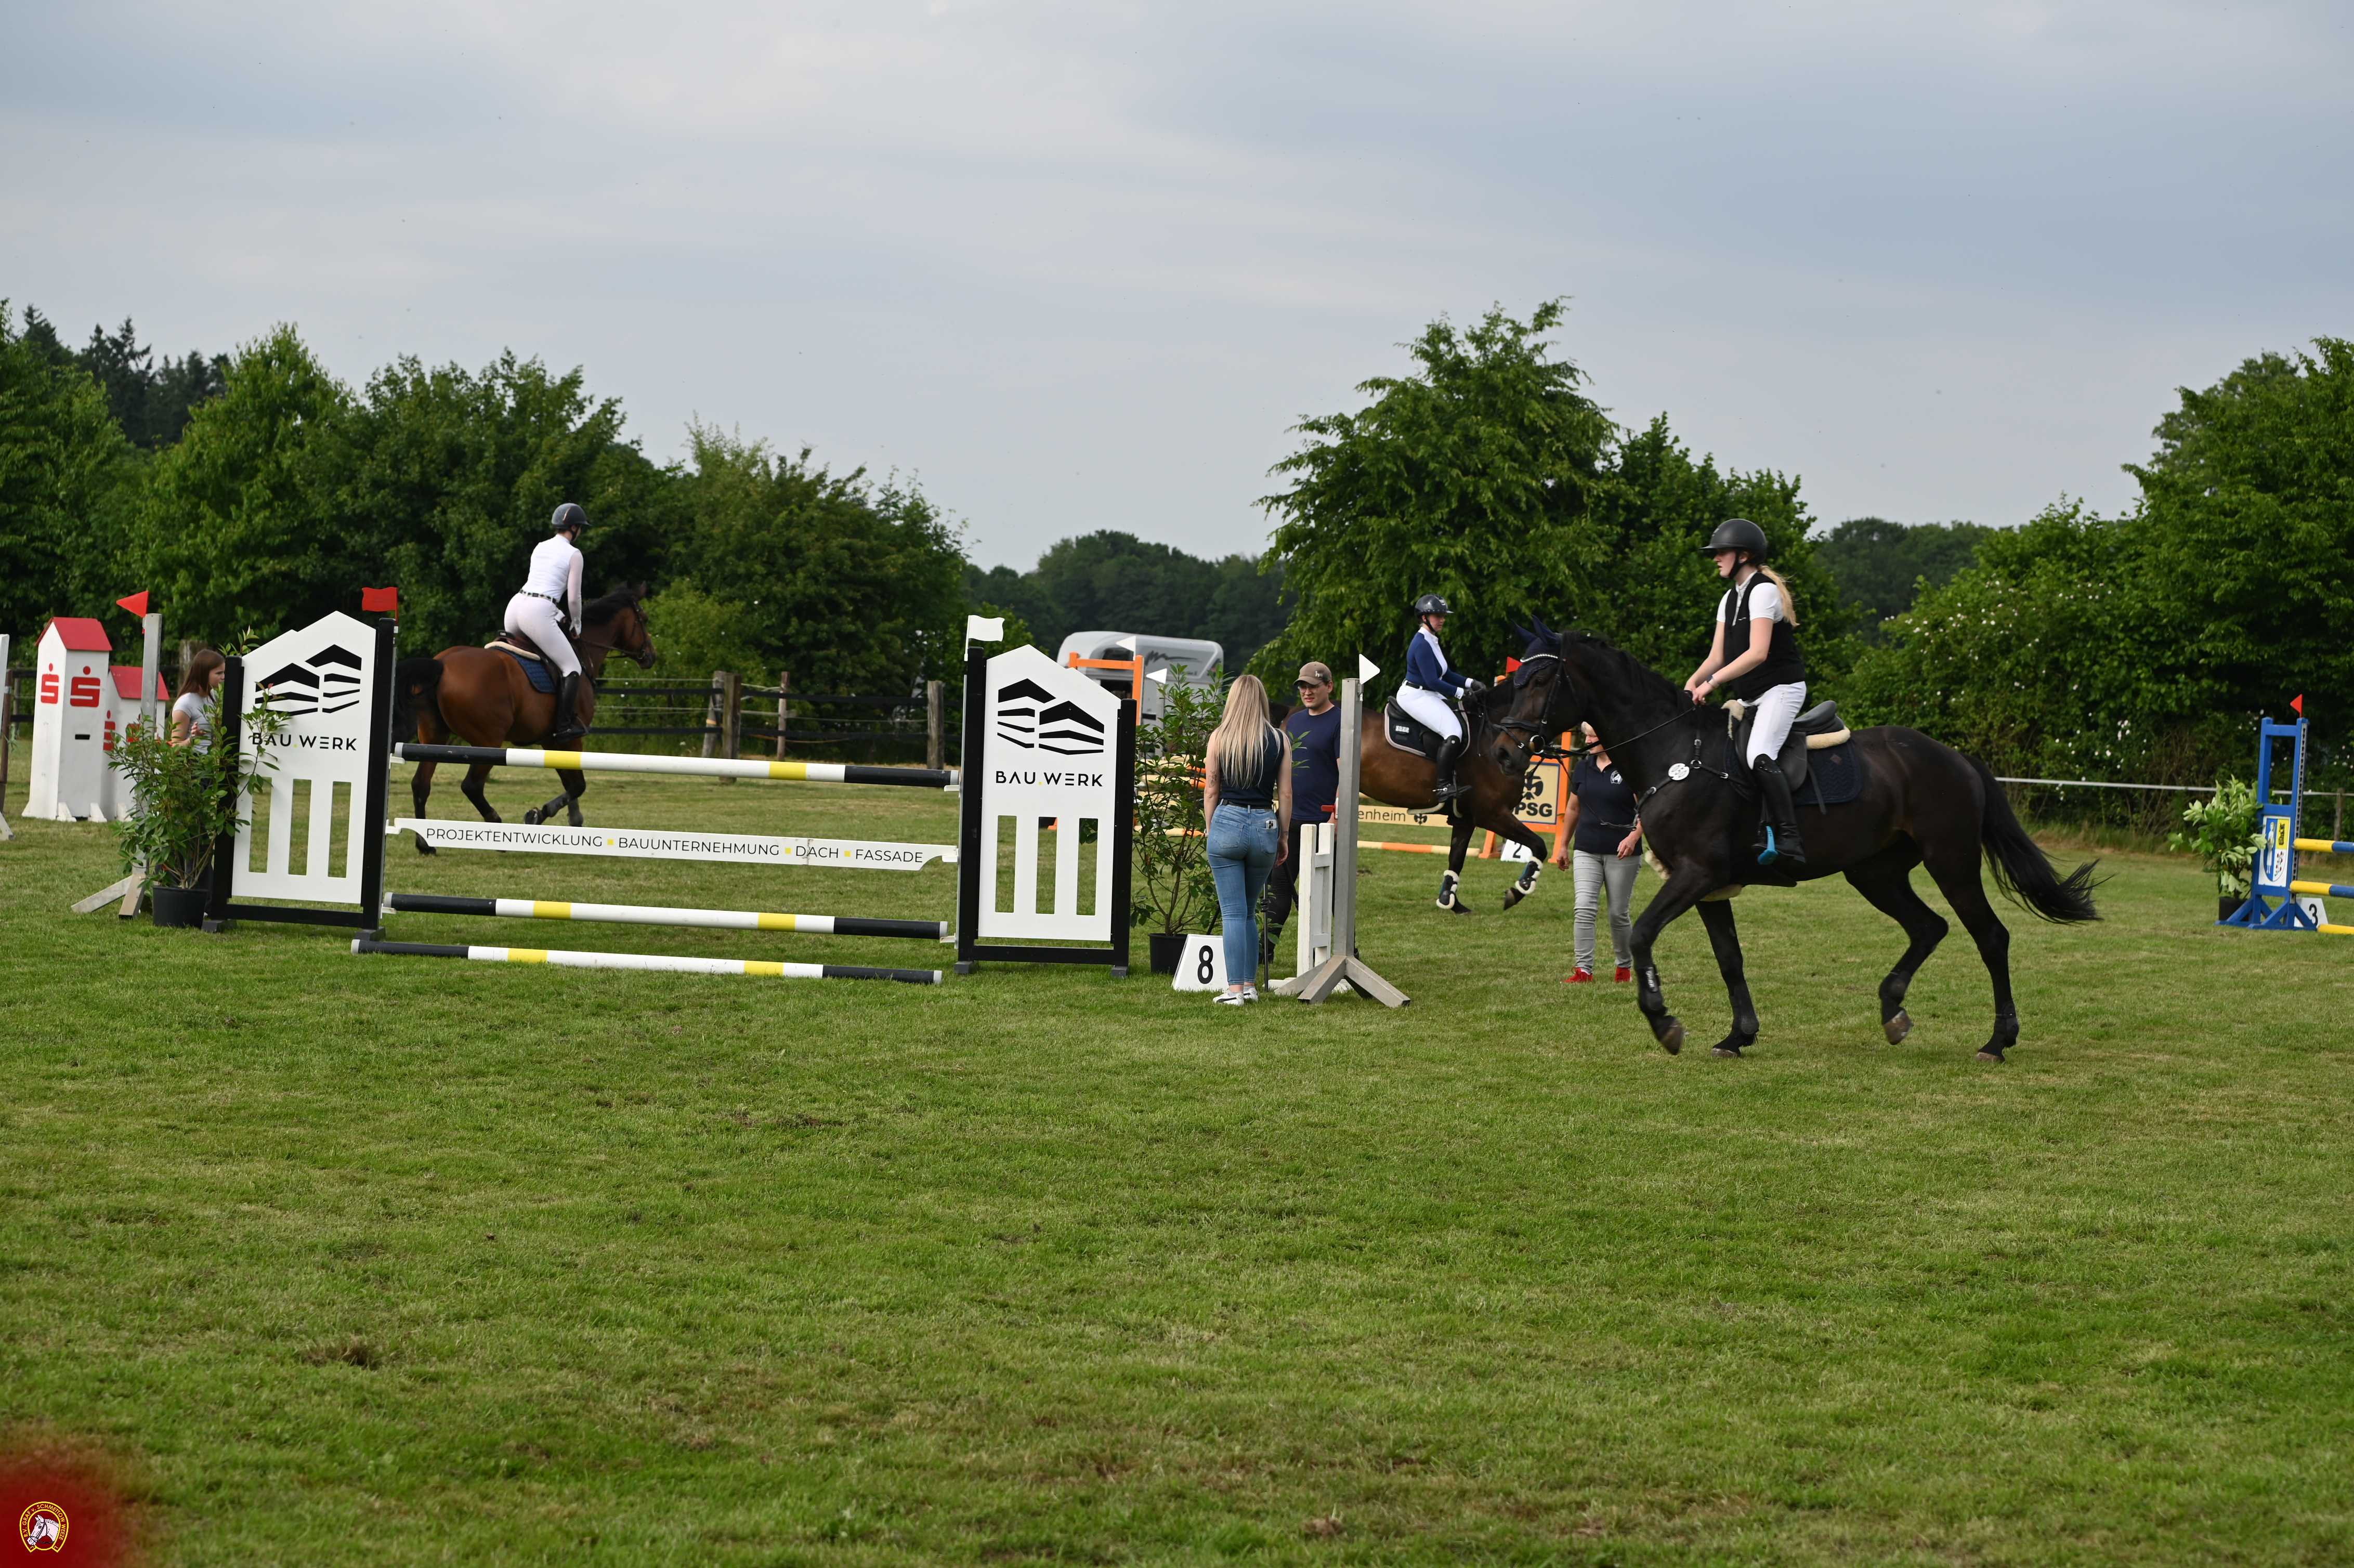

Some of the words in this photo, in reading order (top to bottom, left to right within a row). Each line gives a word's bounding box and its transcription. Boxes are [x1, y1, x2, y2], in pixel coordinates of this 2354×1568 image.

[1511, 802, 1552, 817] PSG
[426, 828, 603, 847] PROJEKTENTWICKLUNG
[619, 837, 779, 856] BAUUNTERNEHMUNG
[795, 845, 839, 859] DACH
[855, 849, 923, 863] FASSADE
[1512, 842, 1522, 859] 2
[2309, 904, 2318, 927] 3
[1197, 945, 1213, 984] 8
